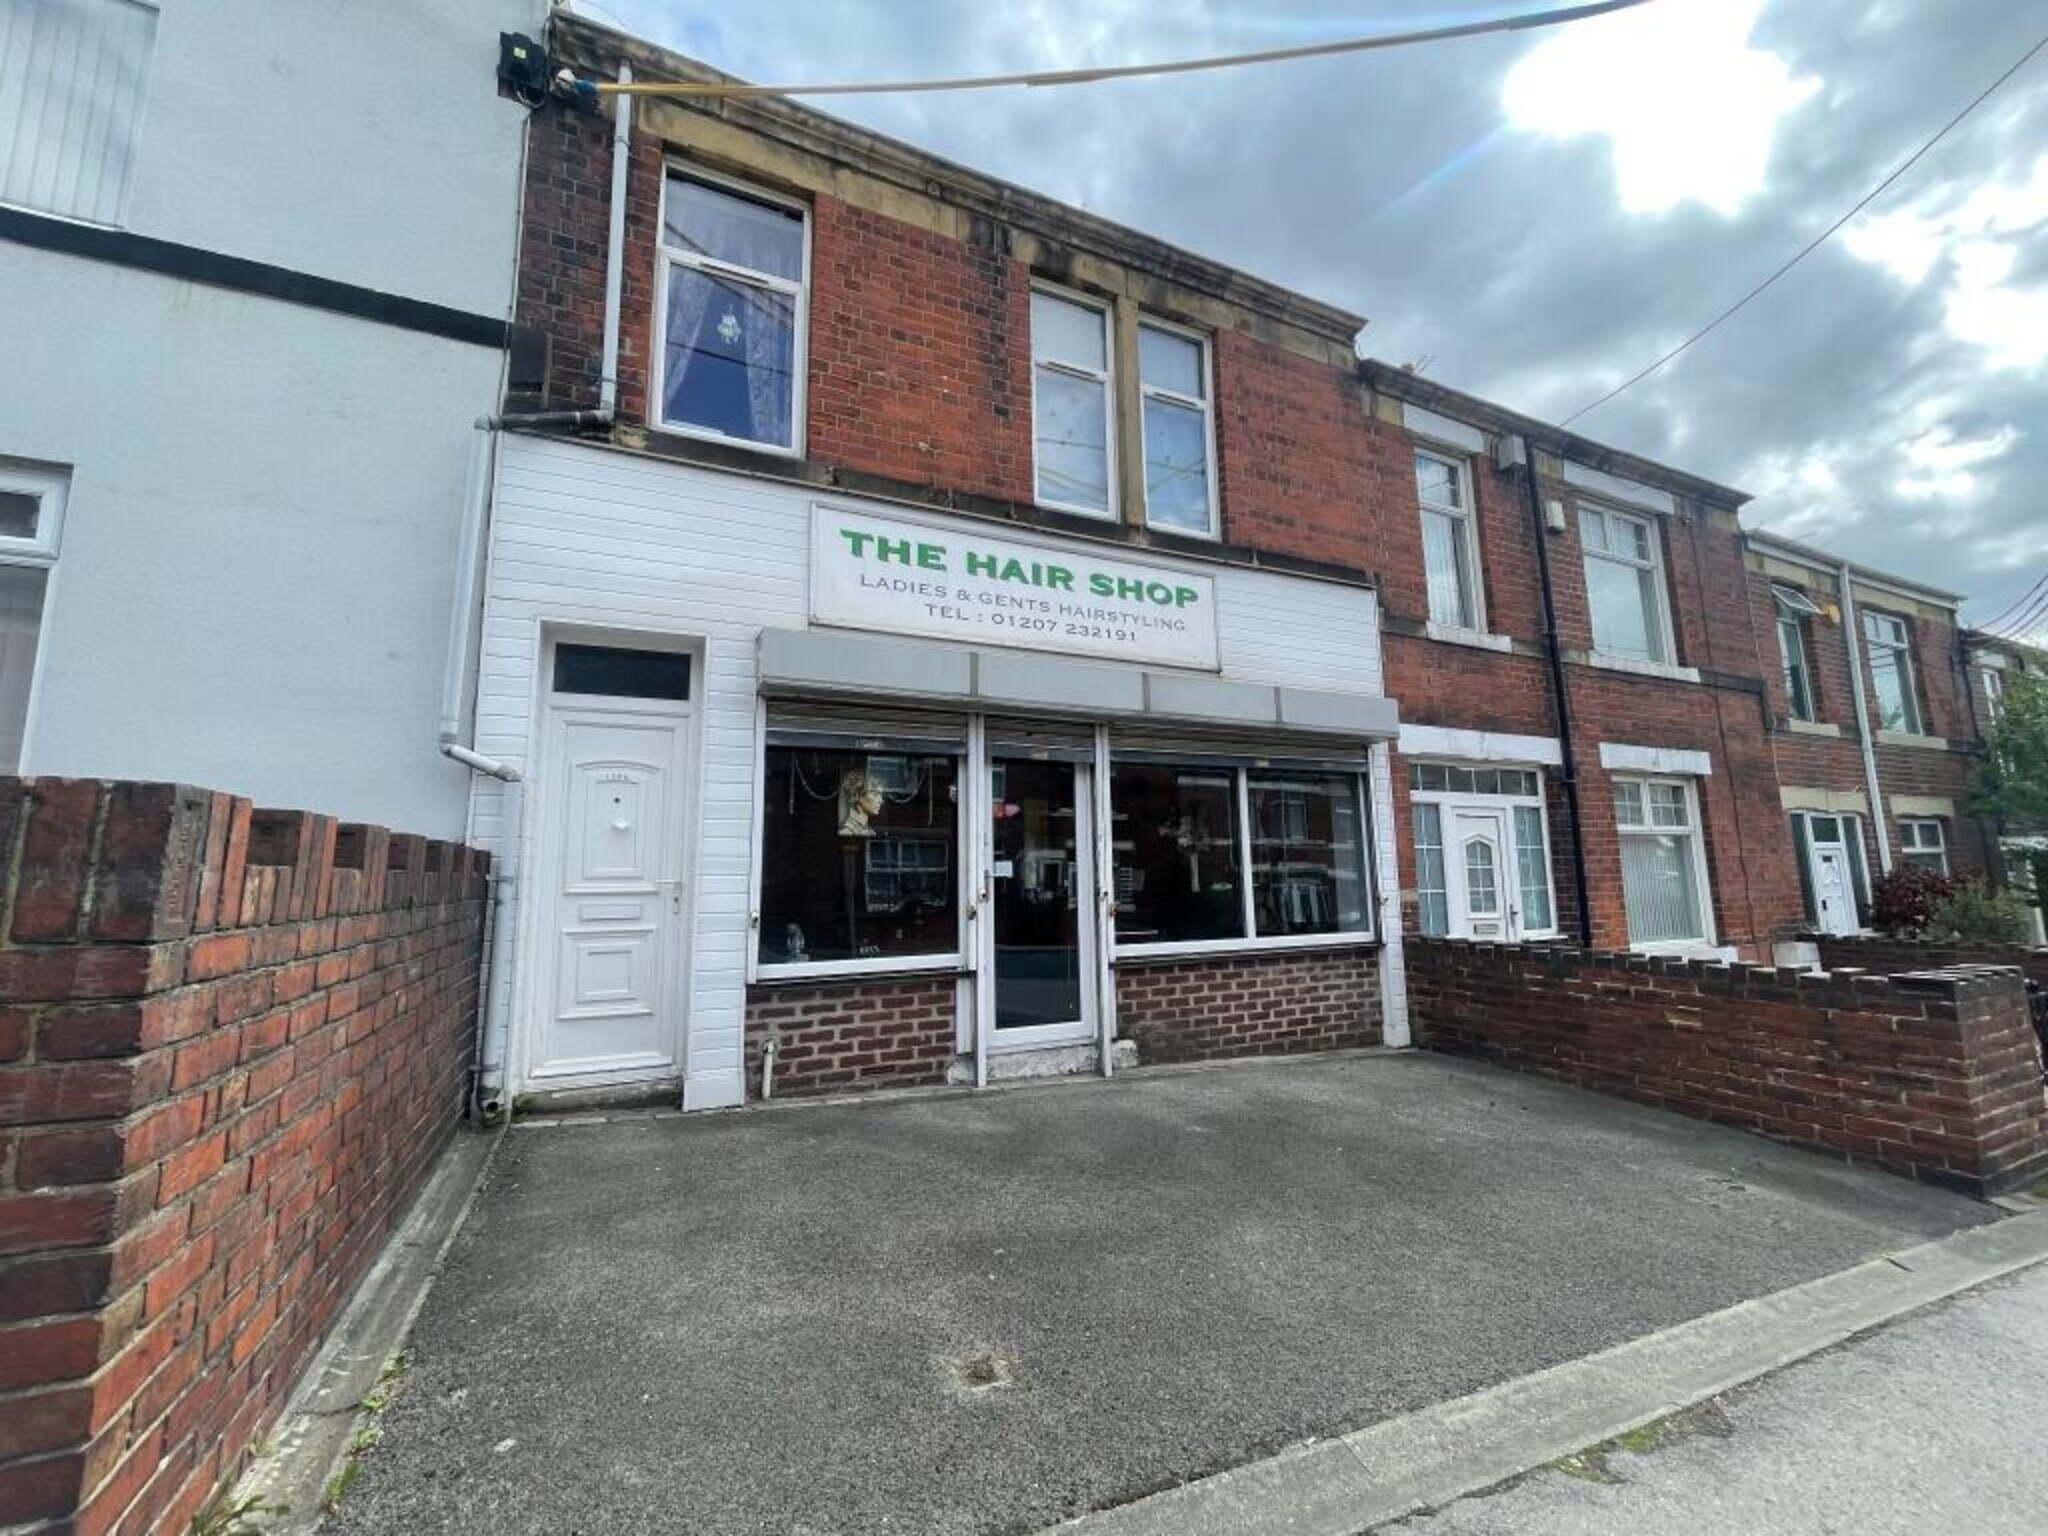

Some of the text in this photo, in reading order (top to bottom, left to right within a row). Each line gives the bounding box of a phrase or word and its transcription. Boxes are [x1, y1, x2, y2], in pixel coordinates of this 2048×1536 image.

[839, 529, 1199, 608] THE HAIR SHOP
[860, 575, 1186, 631] LADIES & GENTS HAIRSTYLING
[991, 613, 1057, 632] 01207
[1065, 623, 1137, 641] 232191
